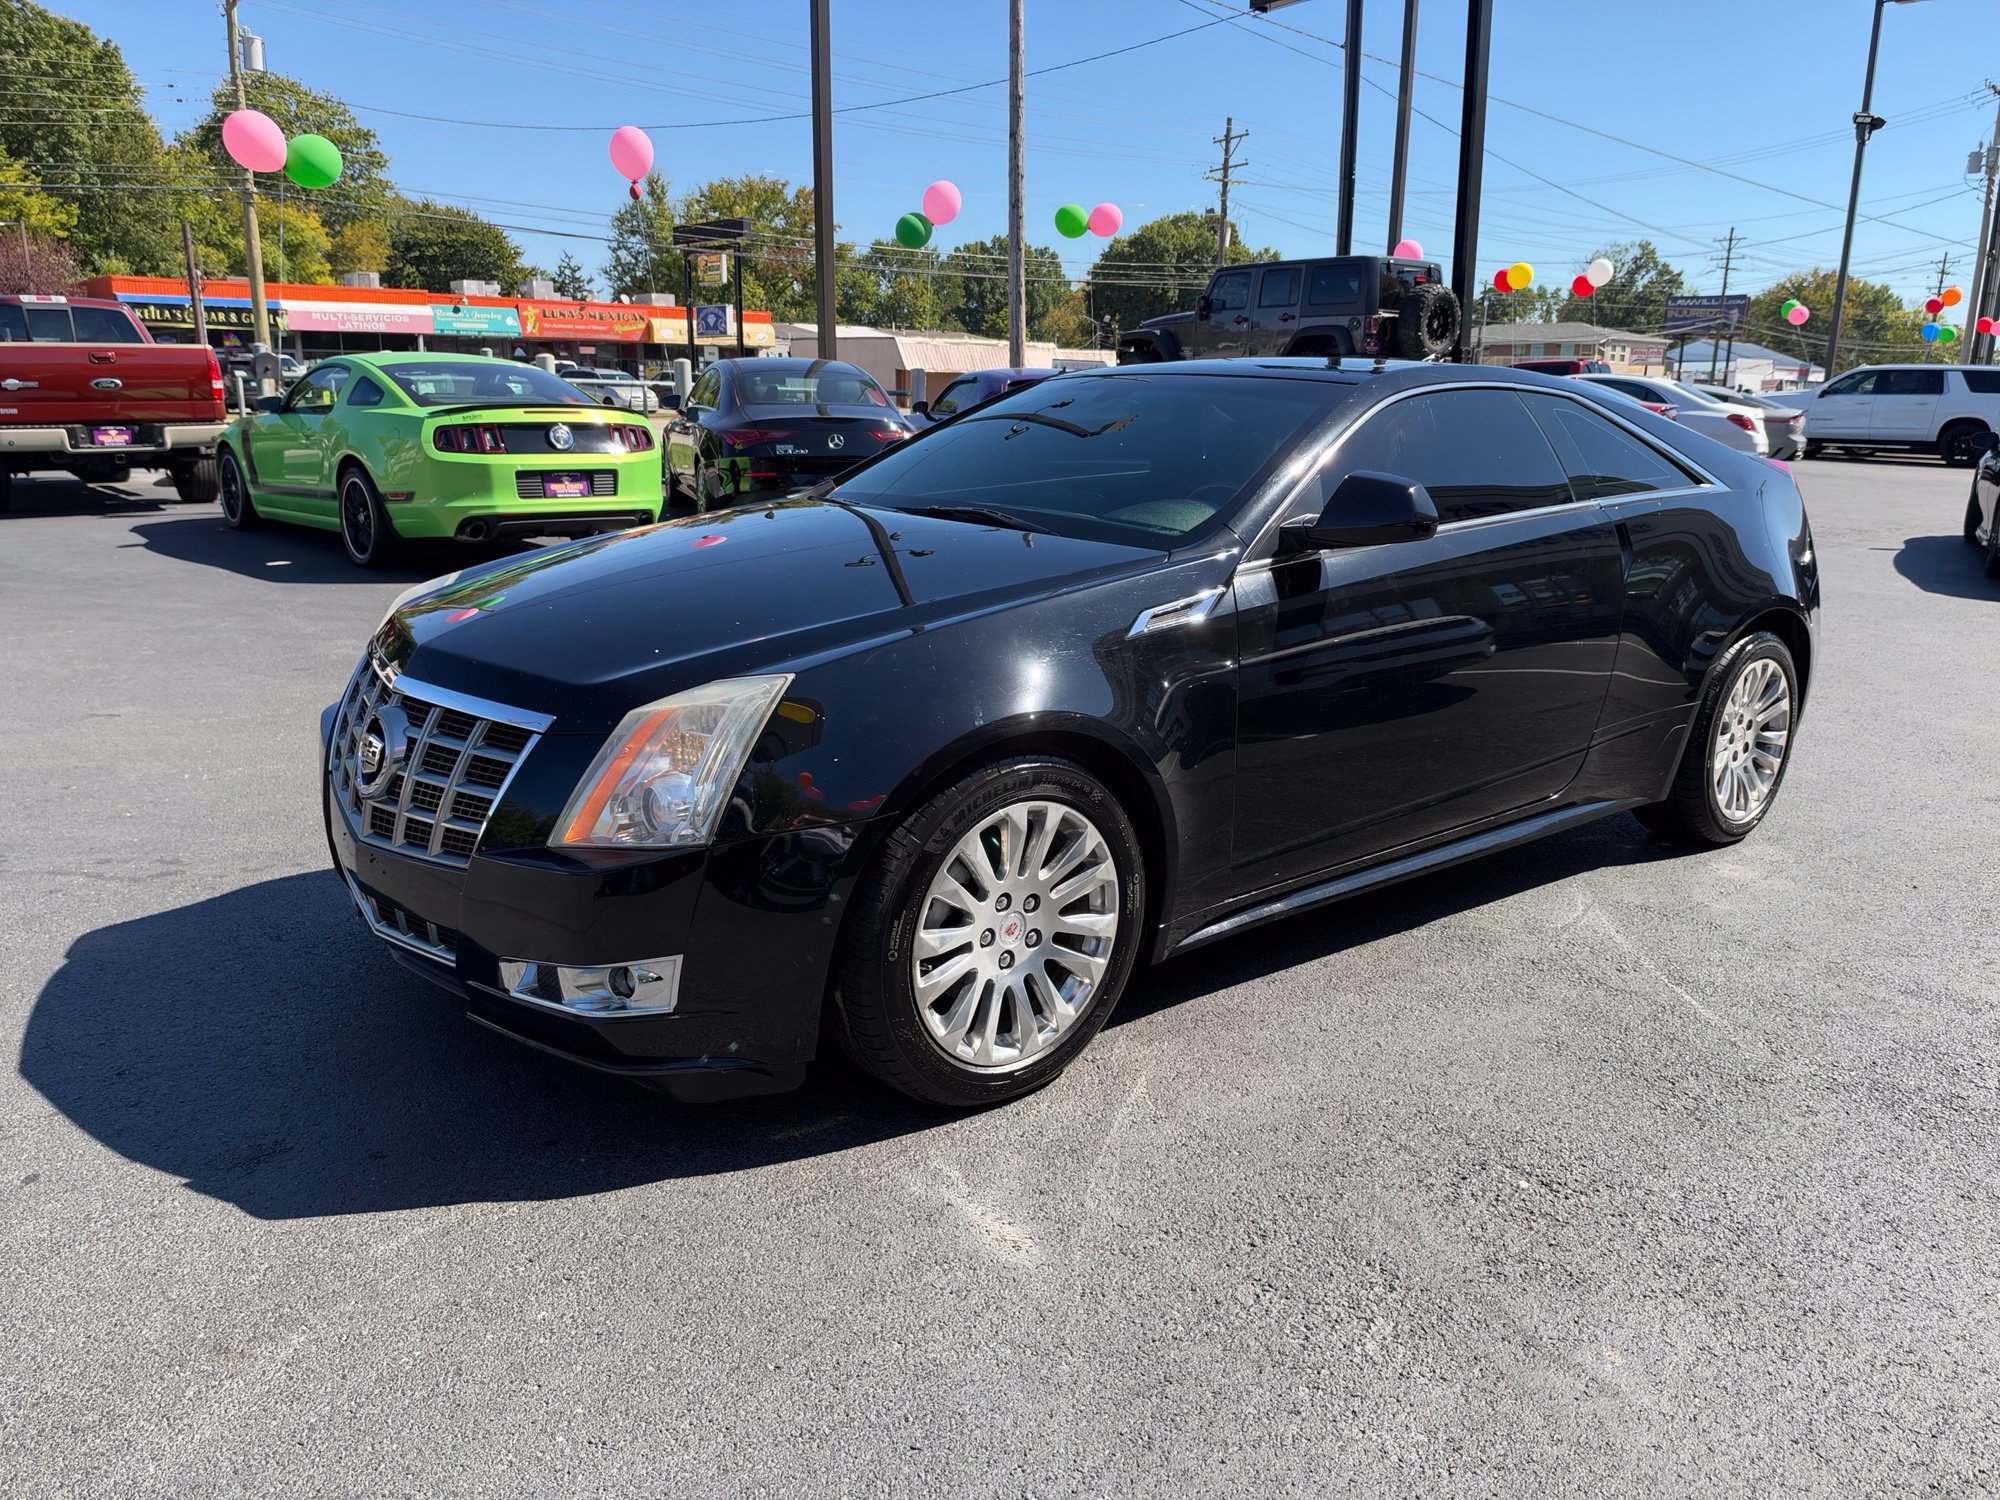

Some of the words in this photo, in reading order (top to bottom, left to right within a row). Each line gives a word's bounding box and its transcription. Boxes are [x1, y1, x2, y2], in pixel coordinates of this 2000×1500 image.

[229, 312, 238, 323] &
[311, 312, 410, 323] MULTI-SERVICIOS
[542, 307, 585, 320] LUNA'S
[588, 309, 646, 322] MEXICAN
[337, 321, 387, 330] LATINOS
[952, 776, 1030, 827] MICHELIN
[1041, 773, 1070, 784] 235/50
